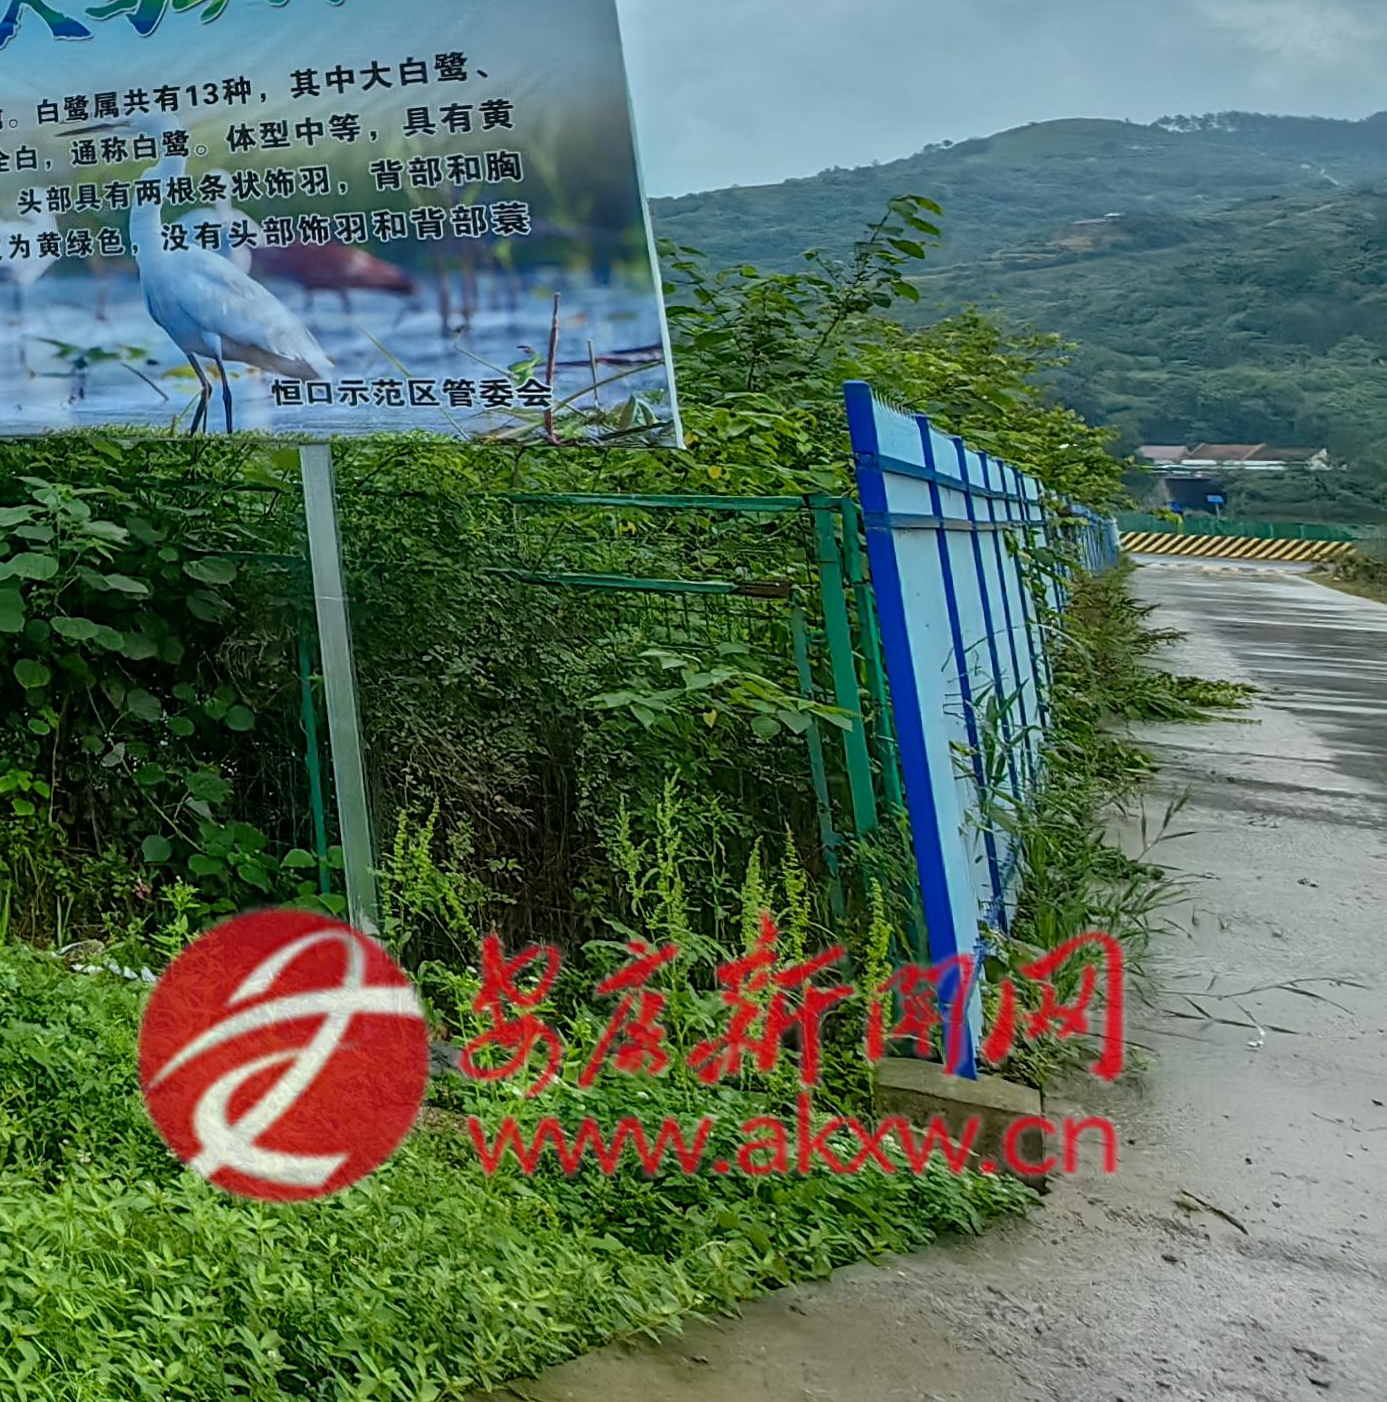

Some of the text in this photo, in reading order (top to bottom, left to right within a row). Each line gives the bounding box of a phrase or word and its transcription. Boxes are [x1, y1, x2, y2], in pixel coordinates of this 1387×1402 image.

[270, 377, 555, 409] 恒口示范区管委会
